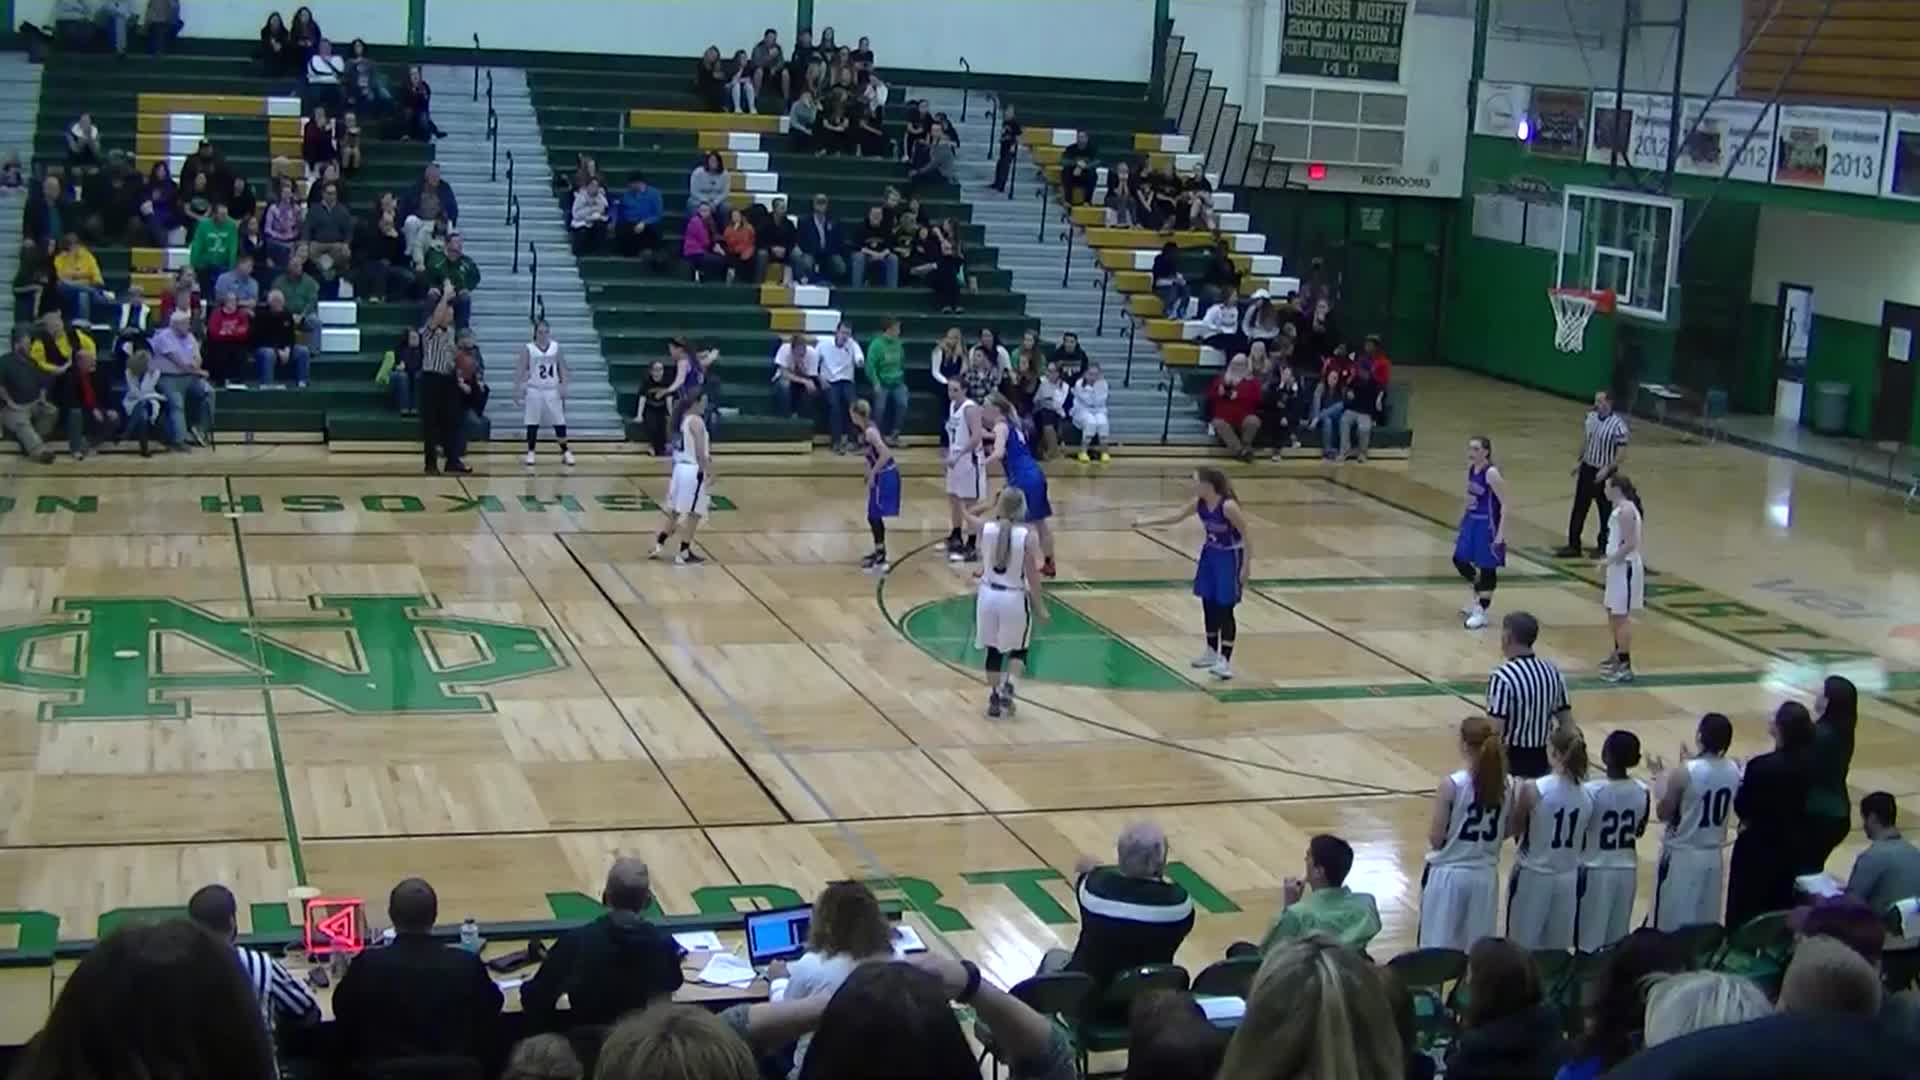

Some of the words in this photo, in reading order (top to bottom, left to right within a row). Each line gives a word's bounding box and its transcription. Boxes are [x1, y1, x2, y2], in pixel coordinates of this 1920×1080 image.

[1356, 2, 1404, 24] NORTH
[1326, 22, 1390, 43] DIVISION
[1361, 175, 1432, 189] RESTROOMS
[1831, 151, 1874, 180] 2013
[1458, 802, 1500, 842] 23
[1698, 787, 1733, 829] 10
[1551, 807, 1581, 849] 11
[1599, 809, 1637, 850] 22
